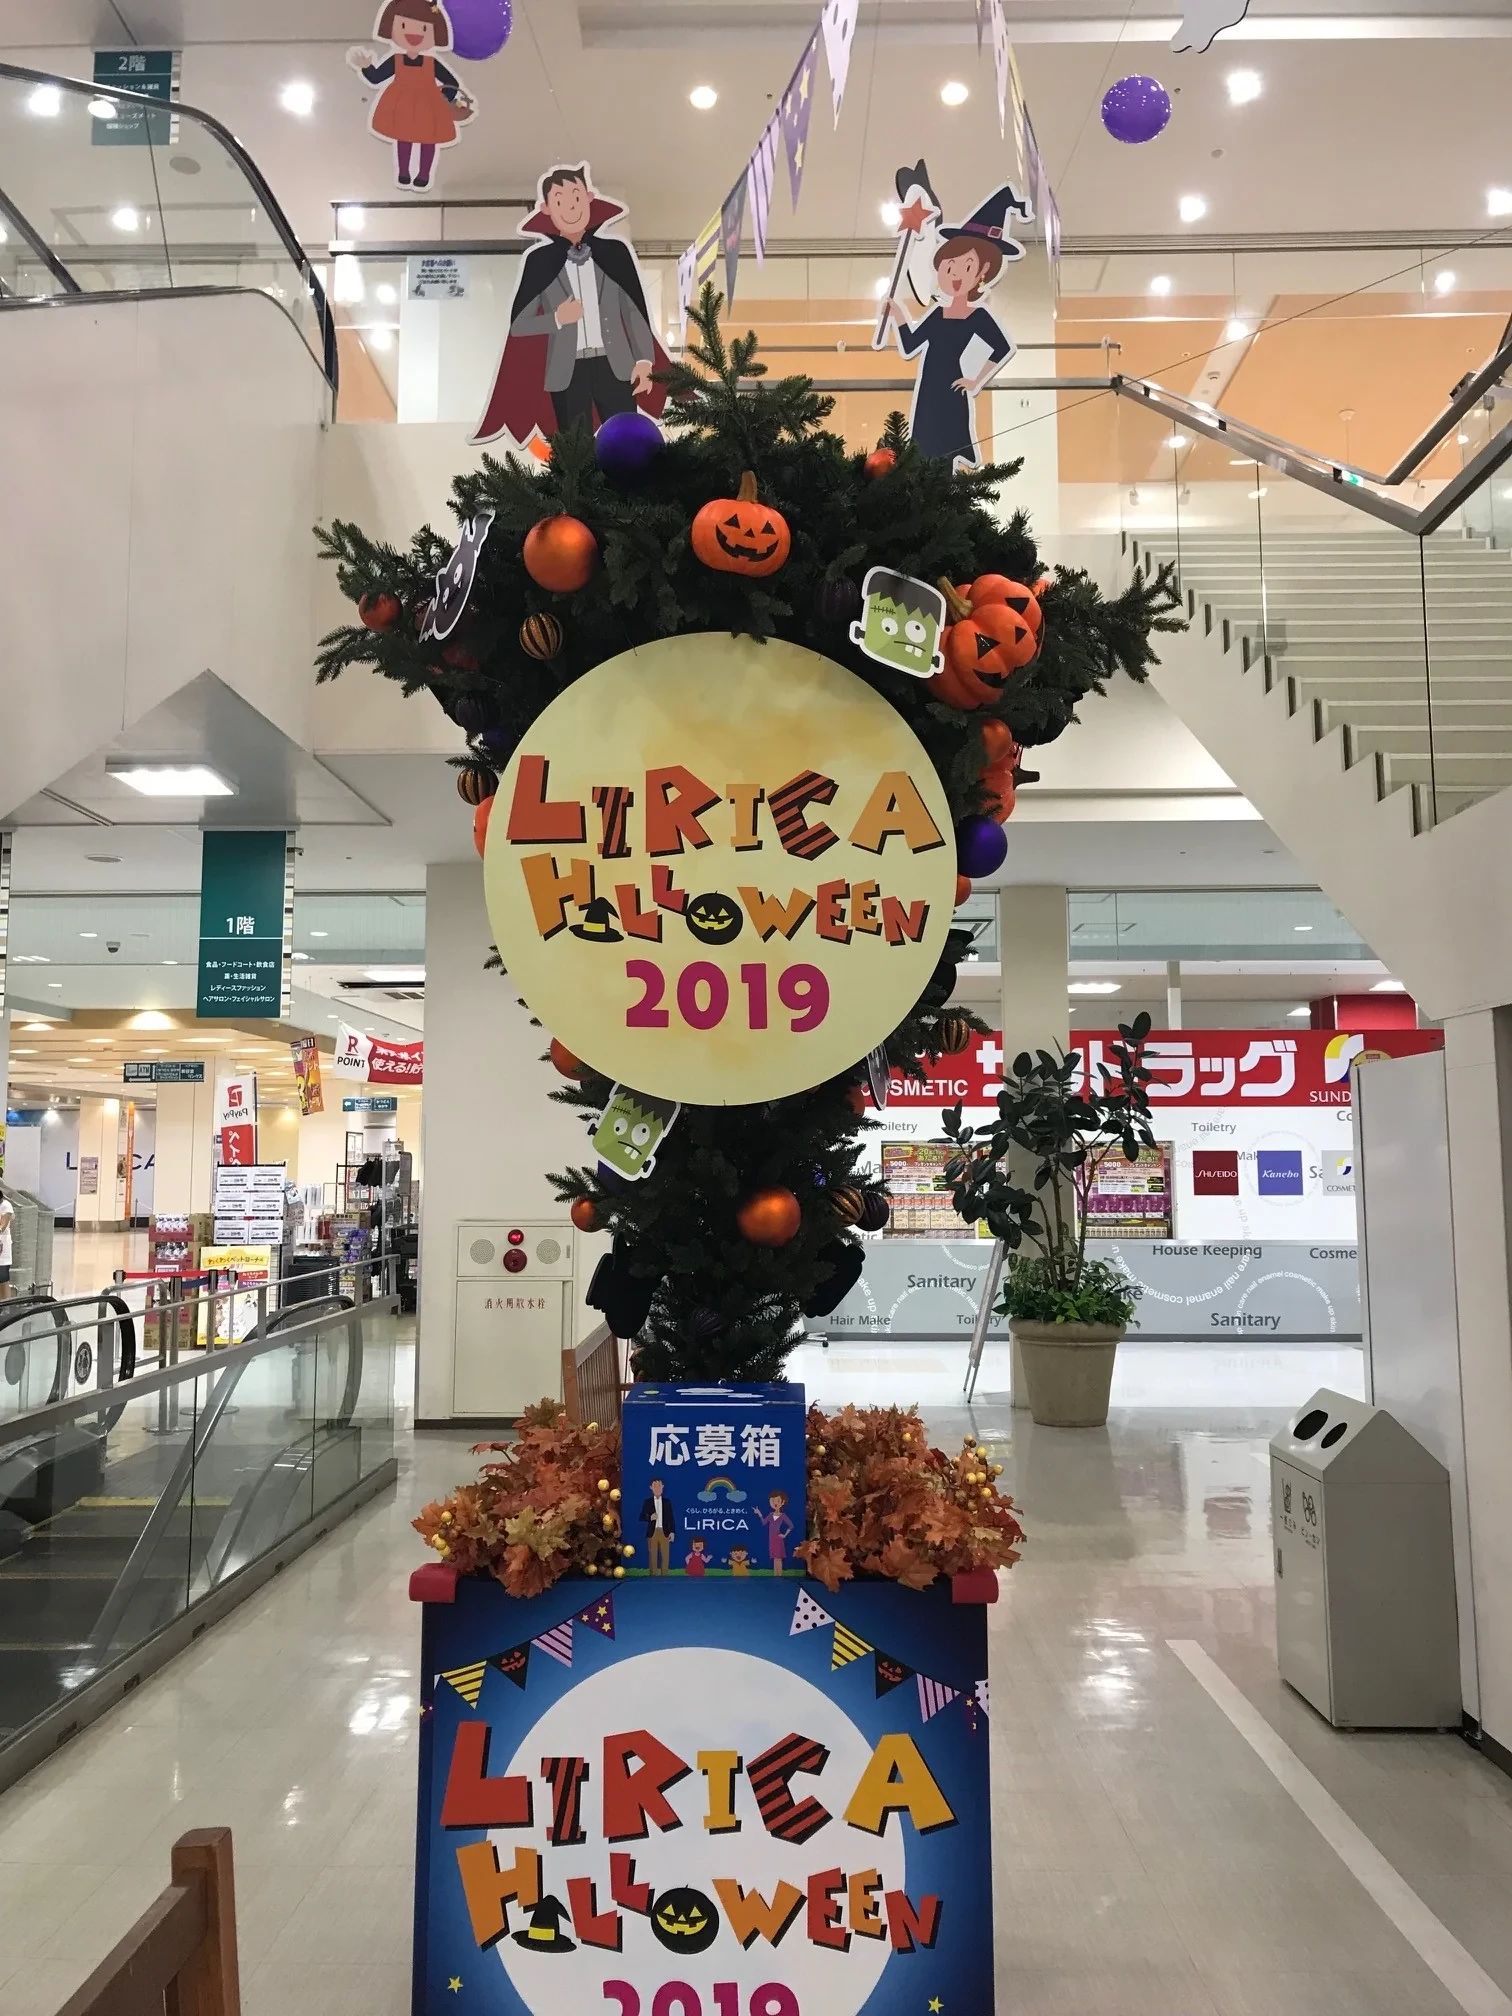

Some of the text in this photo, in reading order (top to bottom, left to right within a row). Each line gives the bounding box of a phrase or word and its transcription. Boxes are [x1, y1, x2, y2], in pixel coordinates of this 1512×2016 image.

[118, 55, 147, 71] 2階
[506, 754, 946, 861] LIRICA
[226, 916, 255, 935] 1階
[625, 959, 830, 1033] 2019
[337, 1056, 365, 1068] POINT
[862, 1079, 968, 1096] SMETIC
[1309, 1090, 1352, 1102] SUND
[1337, 1111, 1352, 1121] Co
[880, 1121, 918, 1133] oiletry
[1191, 1122, 1237, 1134] Toiletry
[1237, 1151, 1258, 1161] Mak
[1195, 1169, 1237, 1178] SHISEIDO
[1261, 1169, 1300, 1180] Kanebo
[1309, 1165, 1323, 1179] Sa
[1152, 1245, 1262, 1259] House Keeping
[1310, 1247, 1358, 1259] Cosme
[1116, 1255, 1137, 1282] make
[857, 1277, 872, 1297] ake
[907, 1274, 977, 1292] Sanitary
[1223, 1271, 1240, 1291] nail
[1238, 1293, 1248, 1309] care
[1246, 1280, 1258, 1294] nail
[1258, 1270, 1284, 1284] enamel
[1284, 1271, 1317, 1288] cosmetic
[1316, 1286, 1331, 1305] make
[1136, 1280, 1183, 1304] cosmetic
[1186, 1286, 1224, 1306] enamel
[830, 1315, 855, 1326] Hair
[858, 1315, 891, 1326] Make
[1210, 1312, 1281, 1329] Sanitary
[648, 1423, 782, 1467] 応募箱
[440, 1721, 959, 1846] LIRICA
